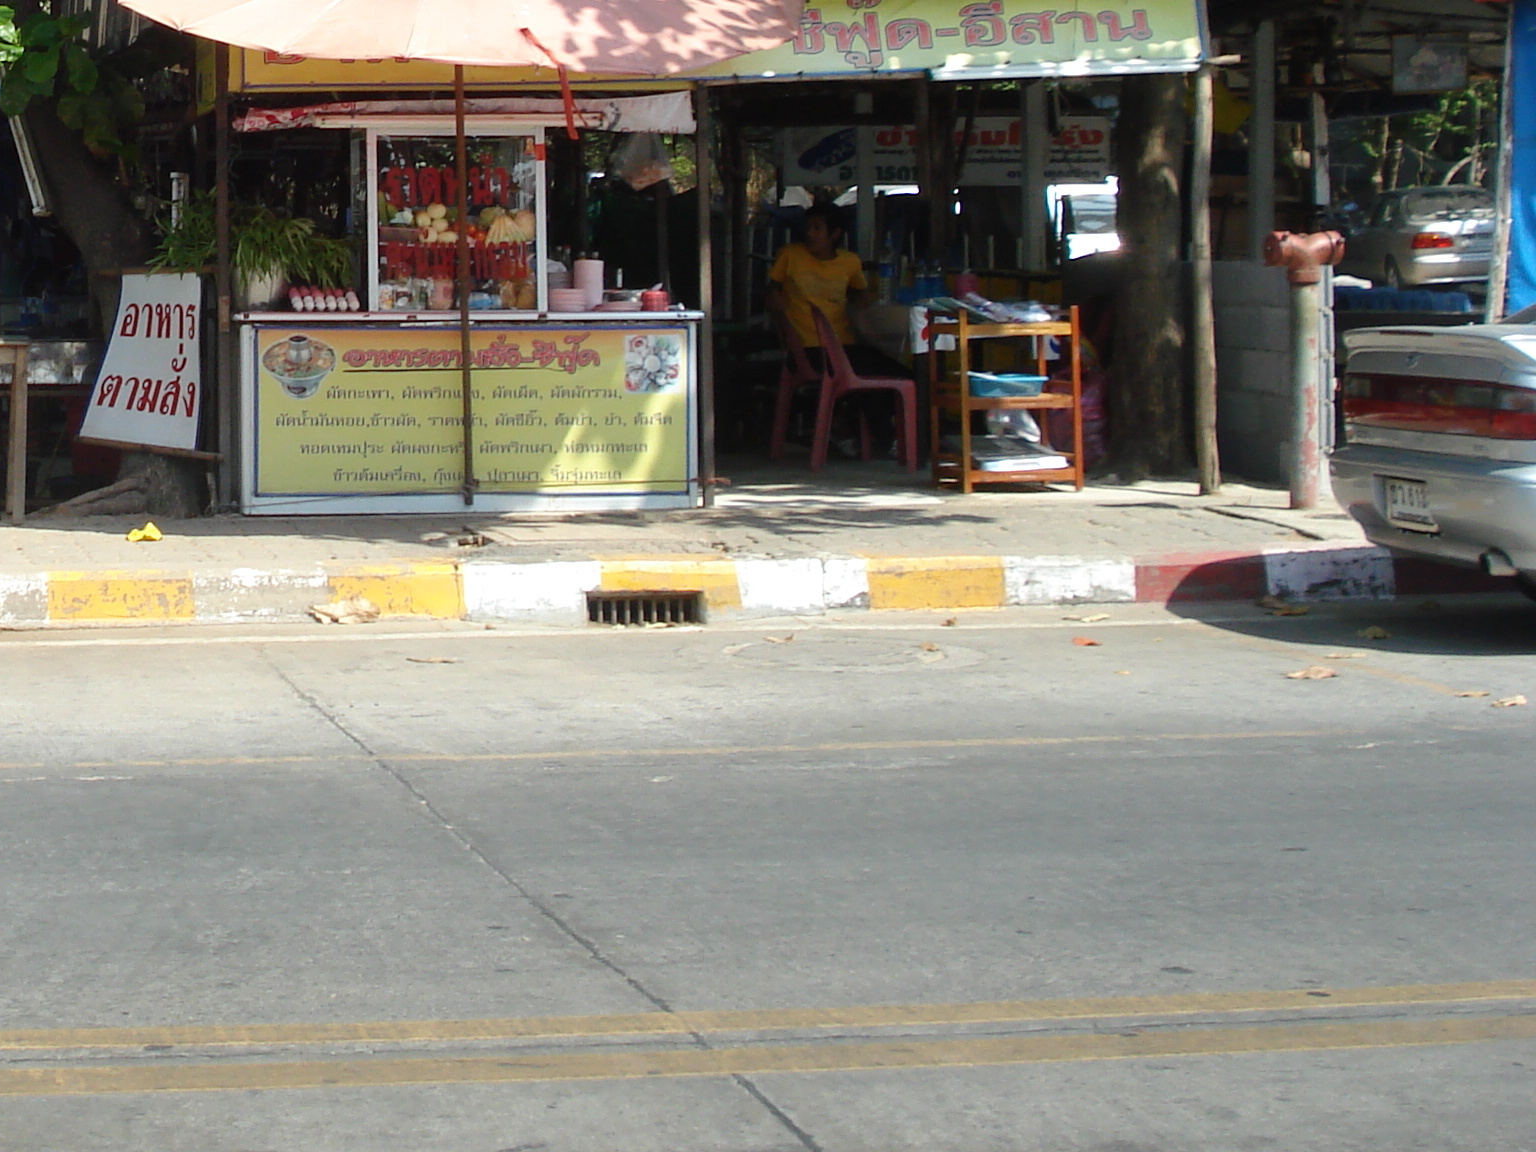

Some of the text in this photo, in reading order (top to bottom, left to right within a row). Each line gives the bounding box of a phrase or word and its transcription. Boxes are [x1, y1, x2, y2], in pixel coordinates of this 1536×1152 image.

[120, 303, 196, 340] อาหาร
[96, 343, 196, 418] ตามสั่ง
[402, 384, 486, 400] ผัดพริกแง,
[427, 412, 488, 428] ราดห้า,
